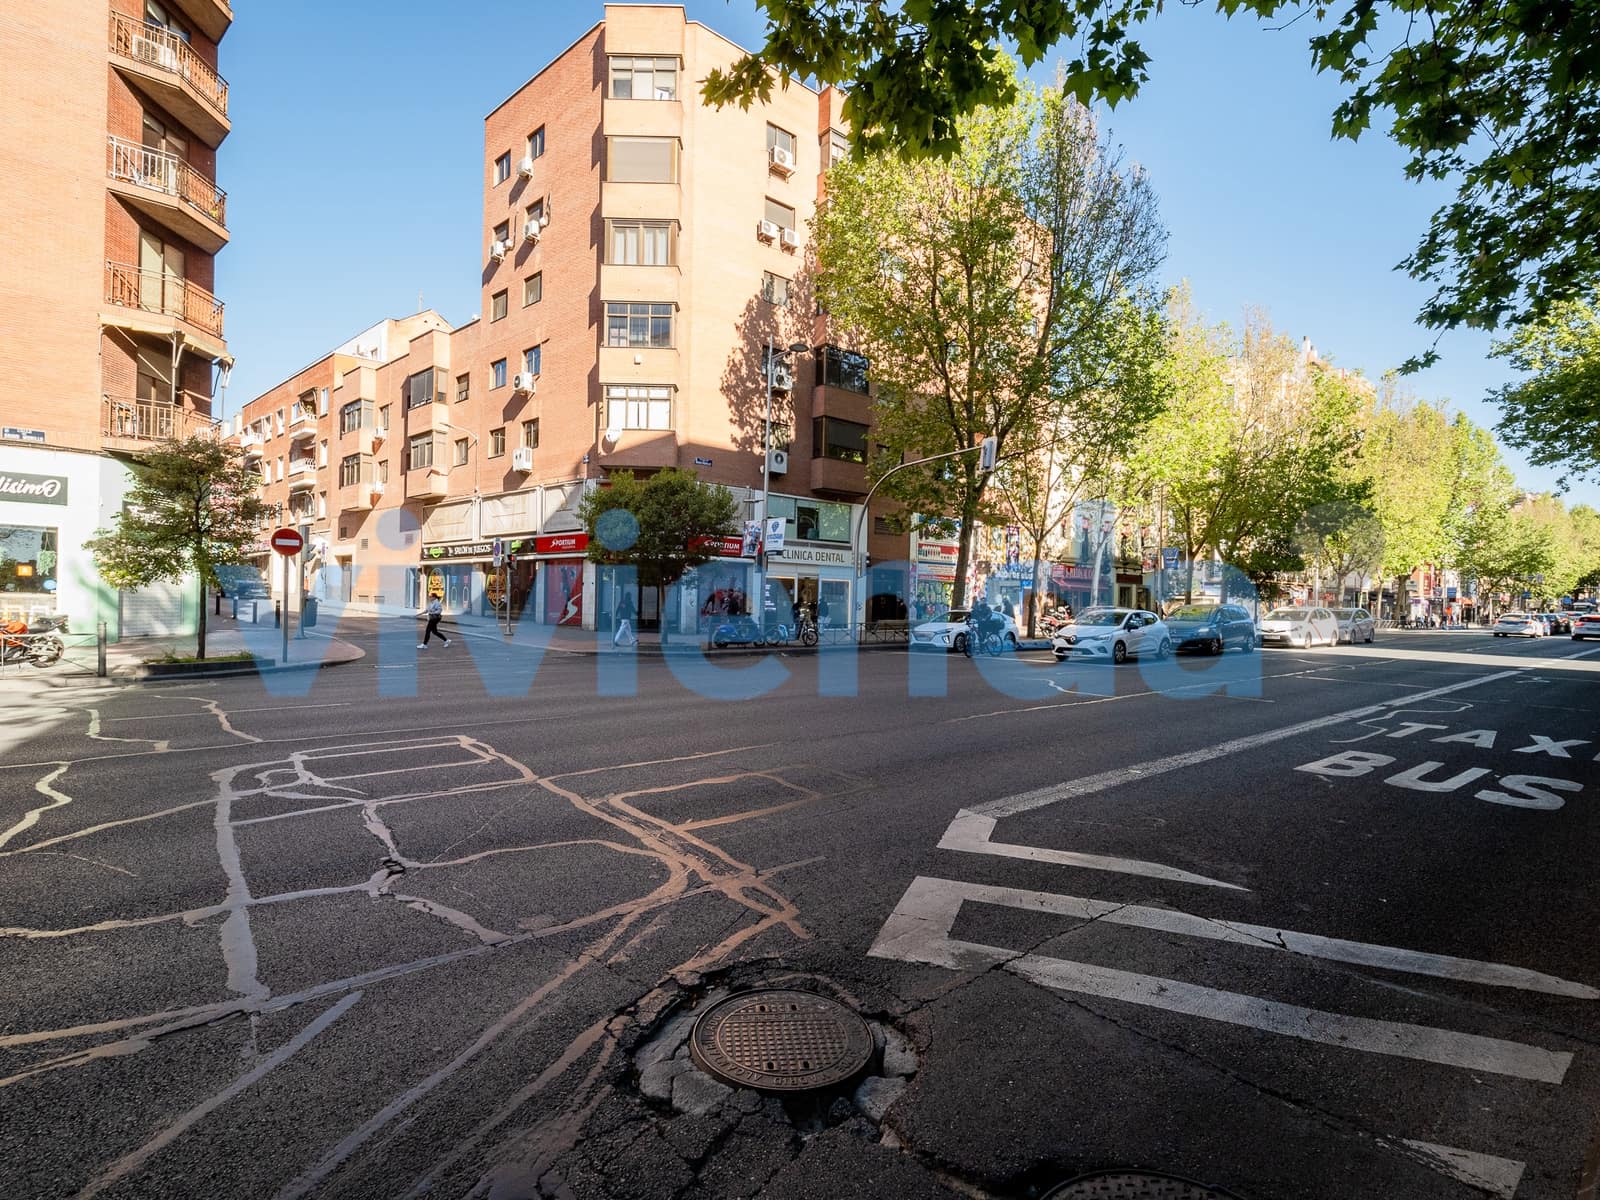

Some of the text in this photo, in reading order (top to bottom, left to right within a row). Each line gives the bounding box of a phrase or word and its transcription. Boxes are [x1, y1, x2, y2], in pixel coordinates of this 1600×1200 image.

[815, 551, 846, 563] DENTAL
[1386, 722, 1600, 761] TAX
[1293, 750, 1584, 811] BUS
